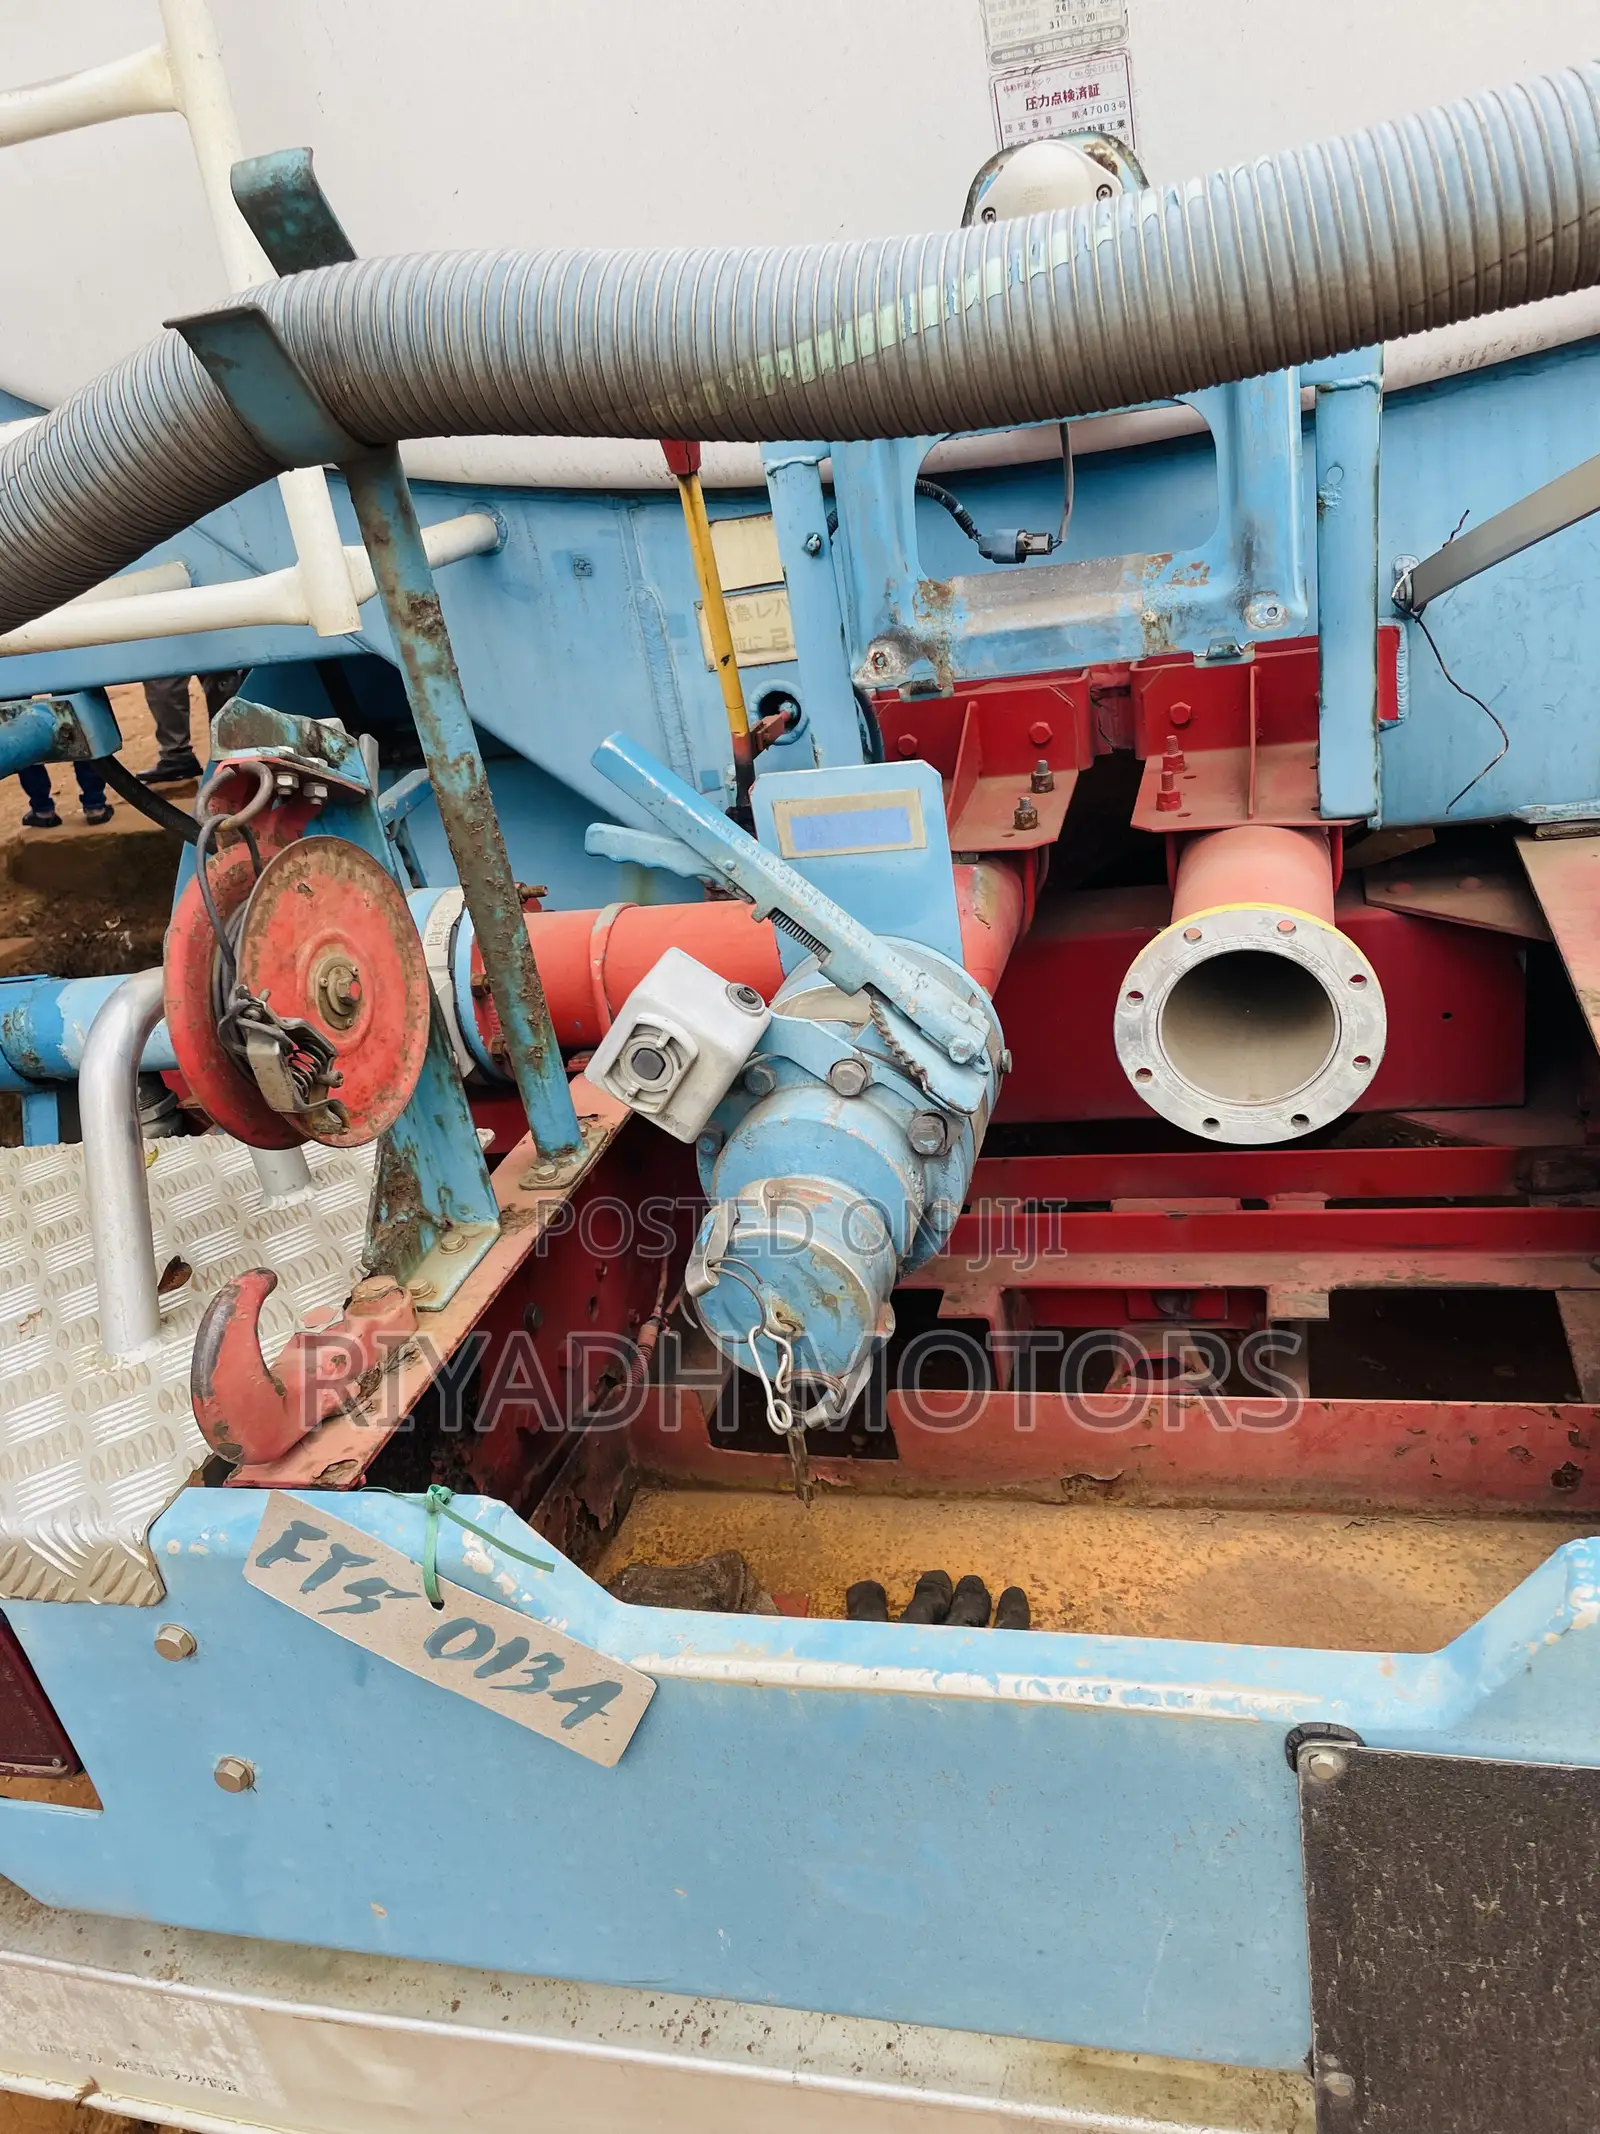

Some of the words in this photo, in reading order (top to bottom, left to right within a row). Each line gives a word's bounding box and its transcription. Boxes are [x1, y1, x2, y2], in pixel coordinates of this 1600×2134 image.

[1025, 83, 1100, 111] 圧力点検済証
[256, 1520, 421, 1615] FTS
